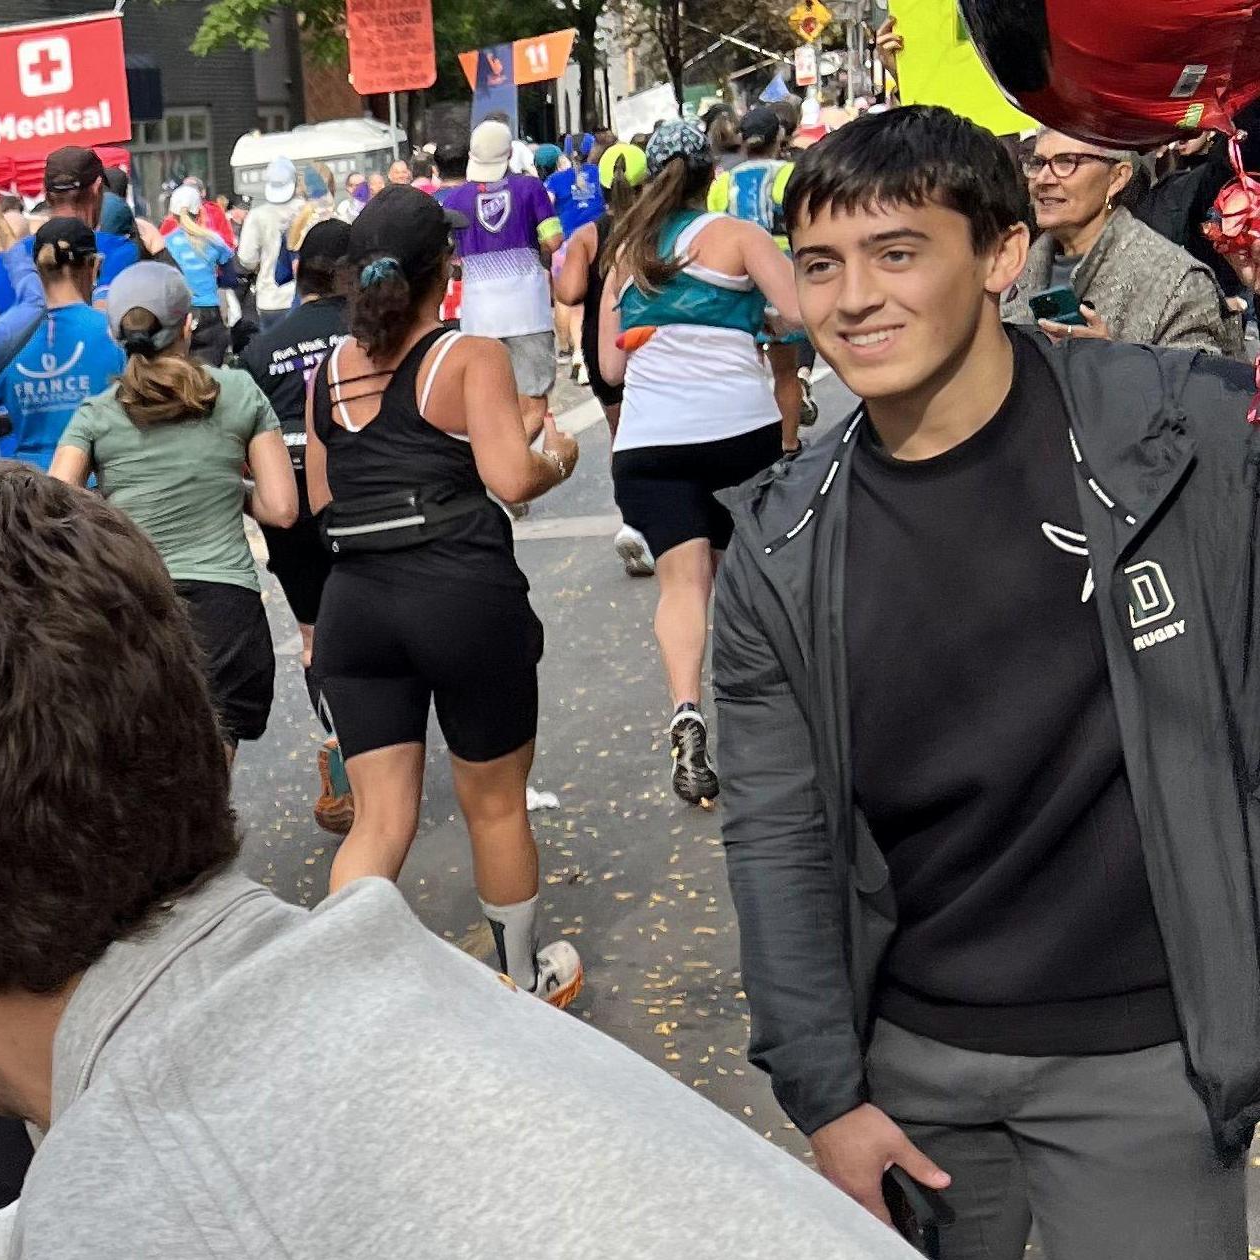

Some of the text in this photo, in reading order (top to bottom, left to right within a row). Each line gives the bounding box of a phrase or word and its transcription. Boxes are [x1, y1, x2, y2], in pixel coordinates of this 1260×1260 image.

[525, 41, 549, 67] 11
[14, 375, 90, 397] FRANCE
[1133, 619, 1185, 651] RUGBY
